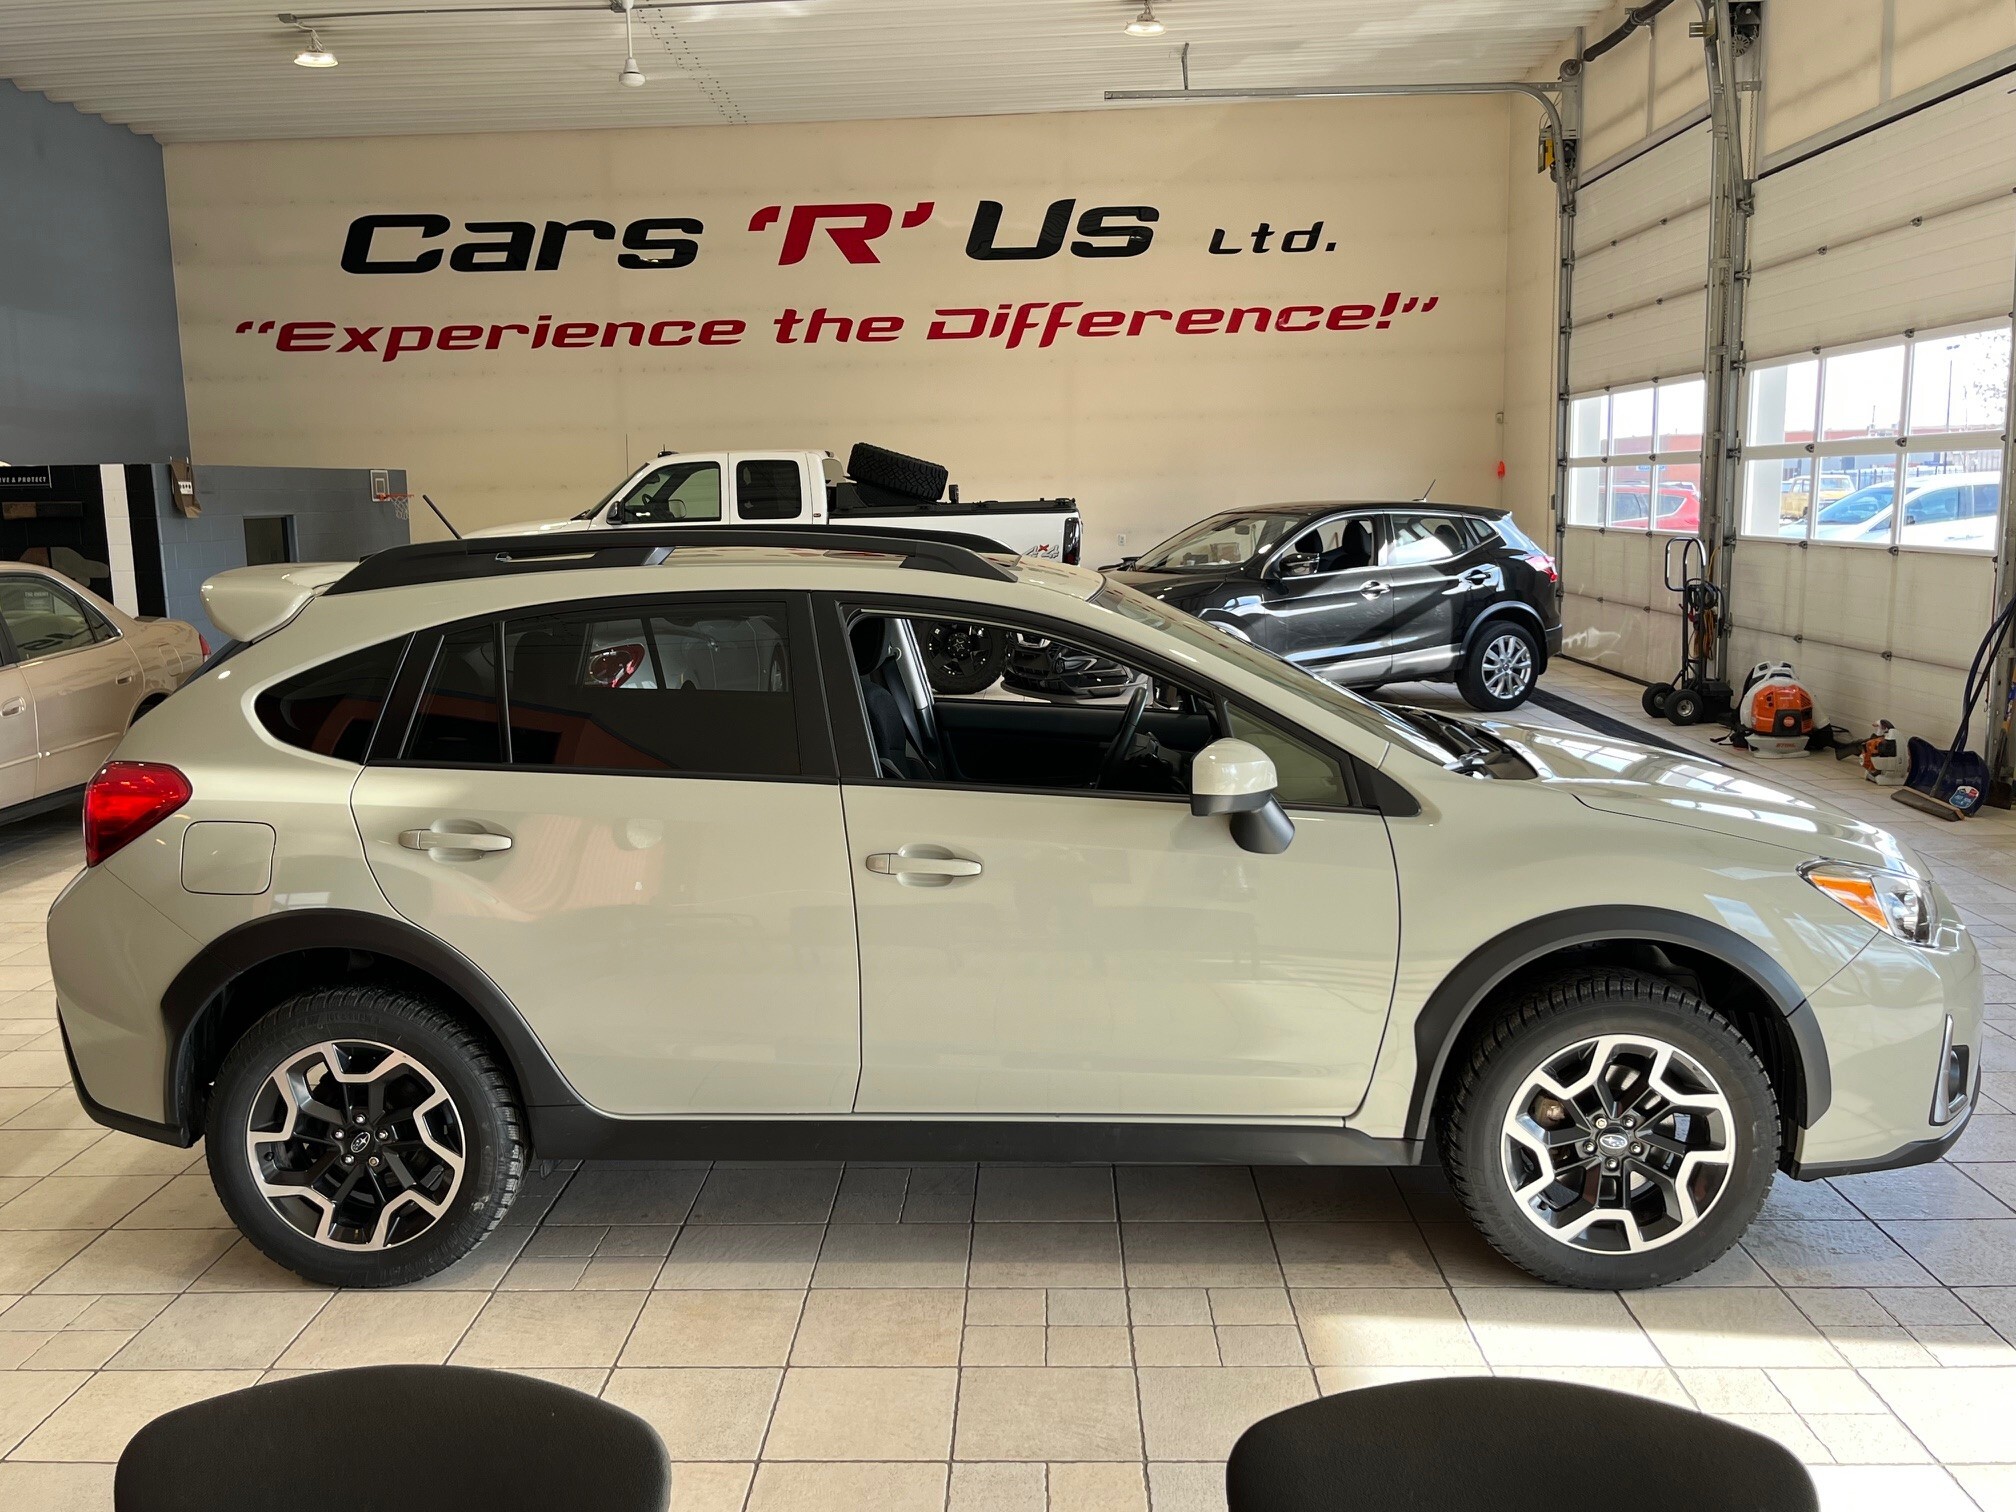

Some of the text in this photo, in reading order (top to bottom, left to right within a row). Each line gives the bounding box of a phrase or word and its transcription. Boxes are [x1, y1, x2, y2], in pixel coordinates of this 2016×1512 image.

[341, 213, 704, 275] Cars
[965, 198, 1160, 261] Us
[1208, 221, 1338, 255] Ltd.
[773, 308, 905, 344] the
